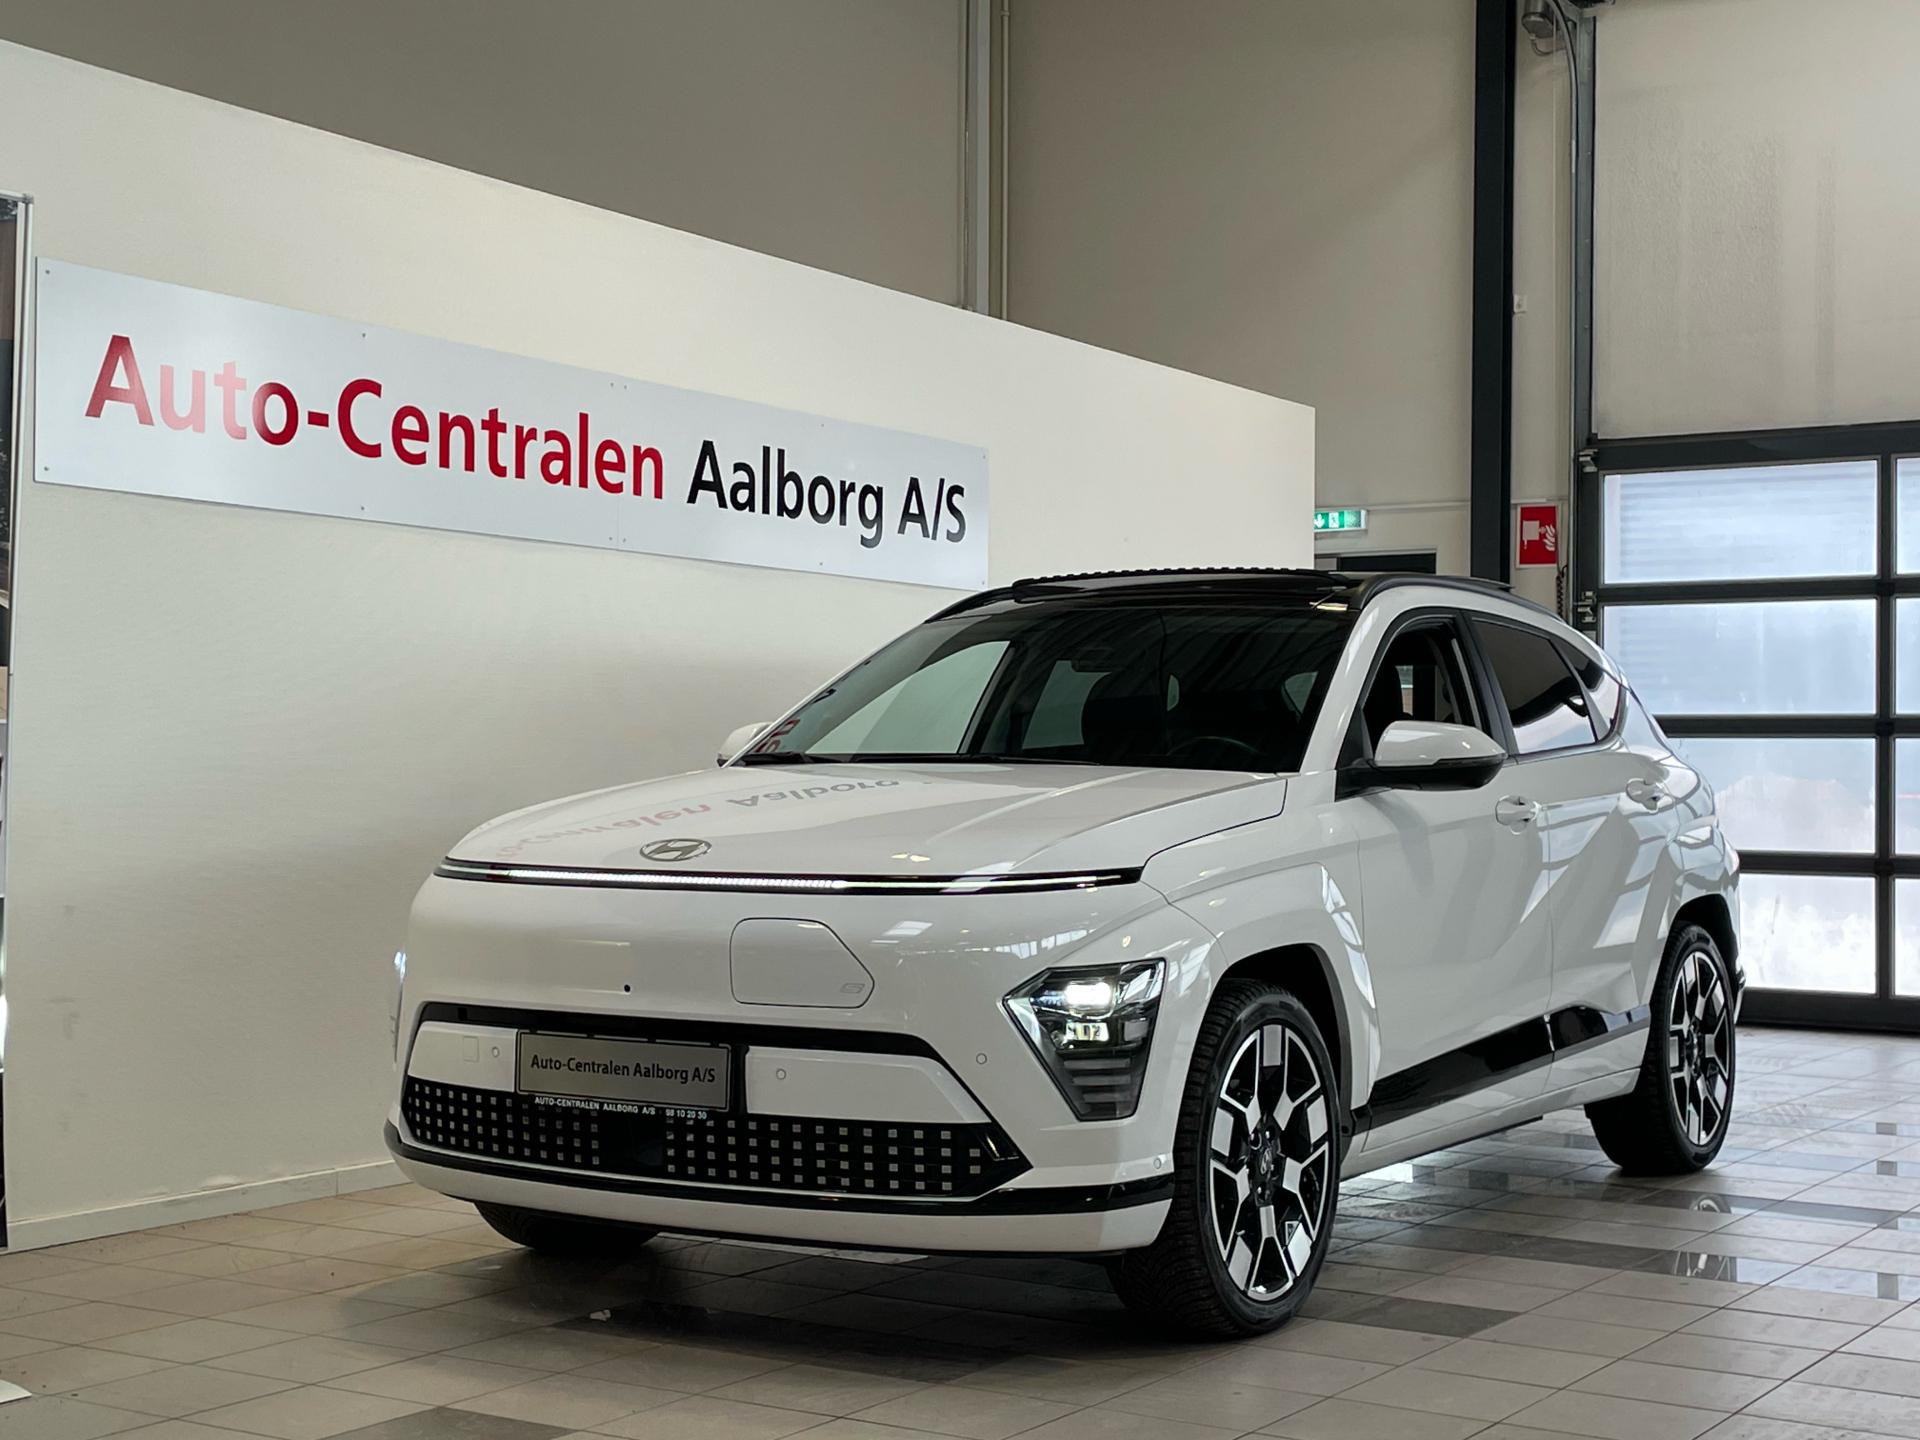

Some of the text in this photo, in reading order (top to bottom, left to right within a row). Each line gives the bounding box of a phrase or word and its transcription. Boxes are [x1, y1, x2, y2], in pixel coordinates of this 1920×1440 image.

[85, 334, 967, 549] Auto-Centralen Aalborg A/S
[531, 1054, 716, 1085] Auto-Centralen Aalborg A/S
[534, 1096, 600, 1110] AUTO-CENTRALEN
[603, 1102, 639, 1114] AALBORG
[642, 1106, 656, 1115] A/S
[676, 1109, 686, 1118] 10
[686, 1110, 696, 1119] 20
[697, 1111, 707, 1120] 30
